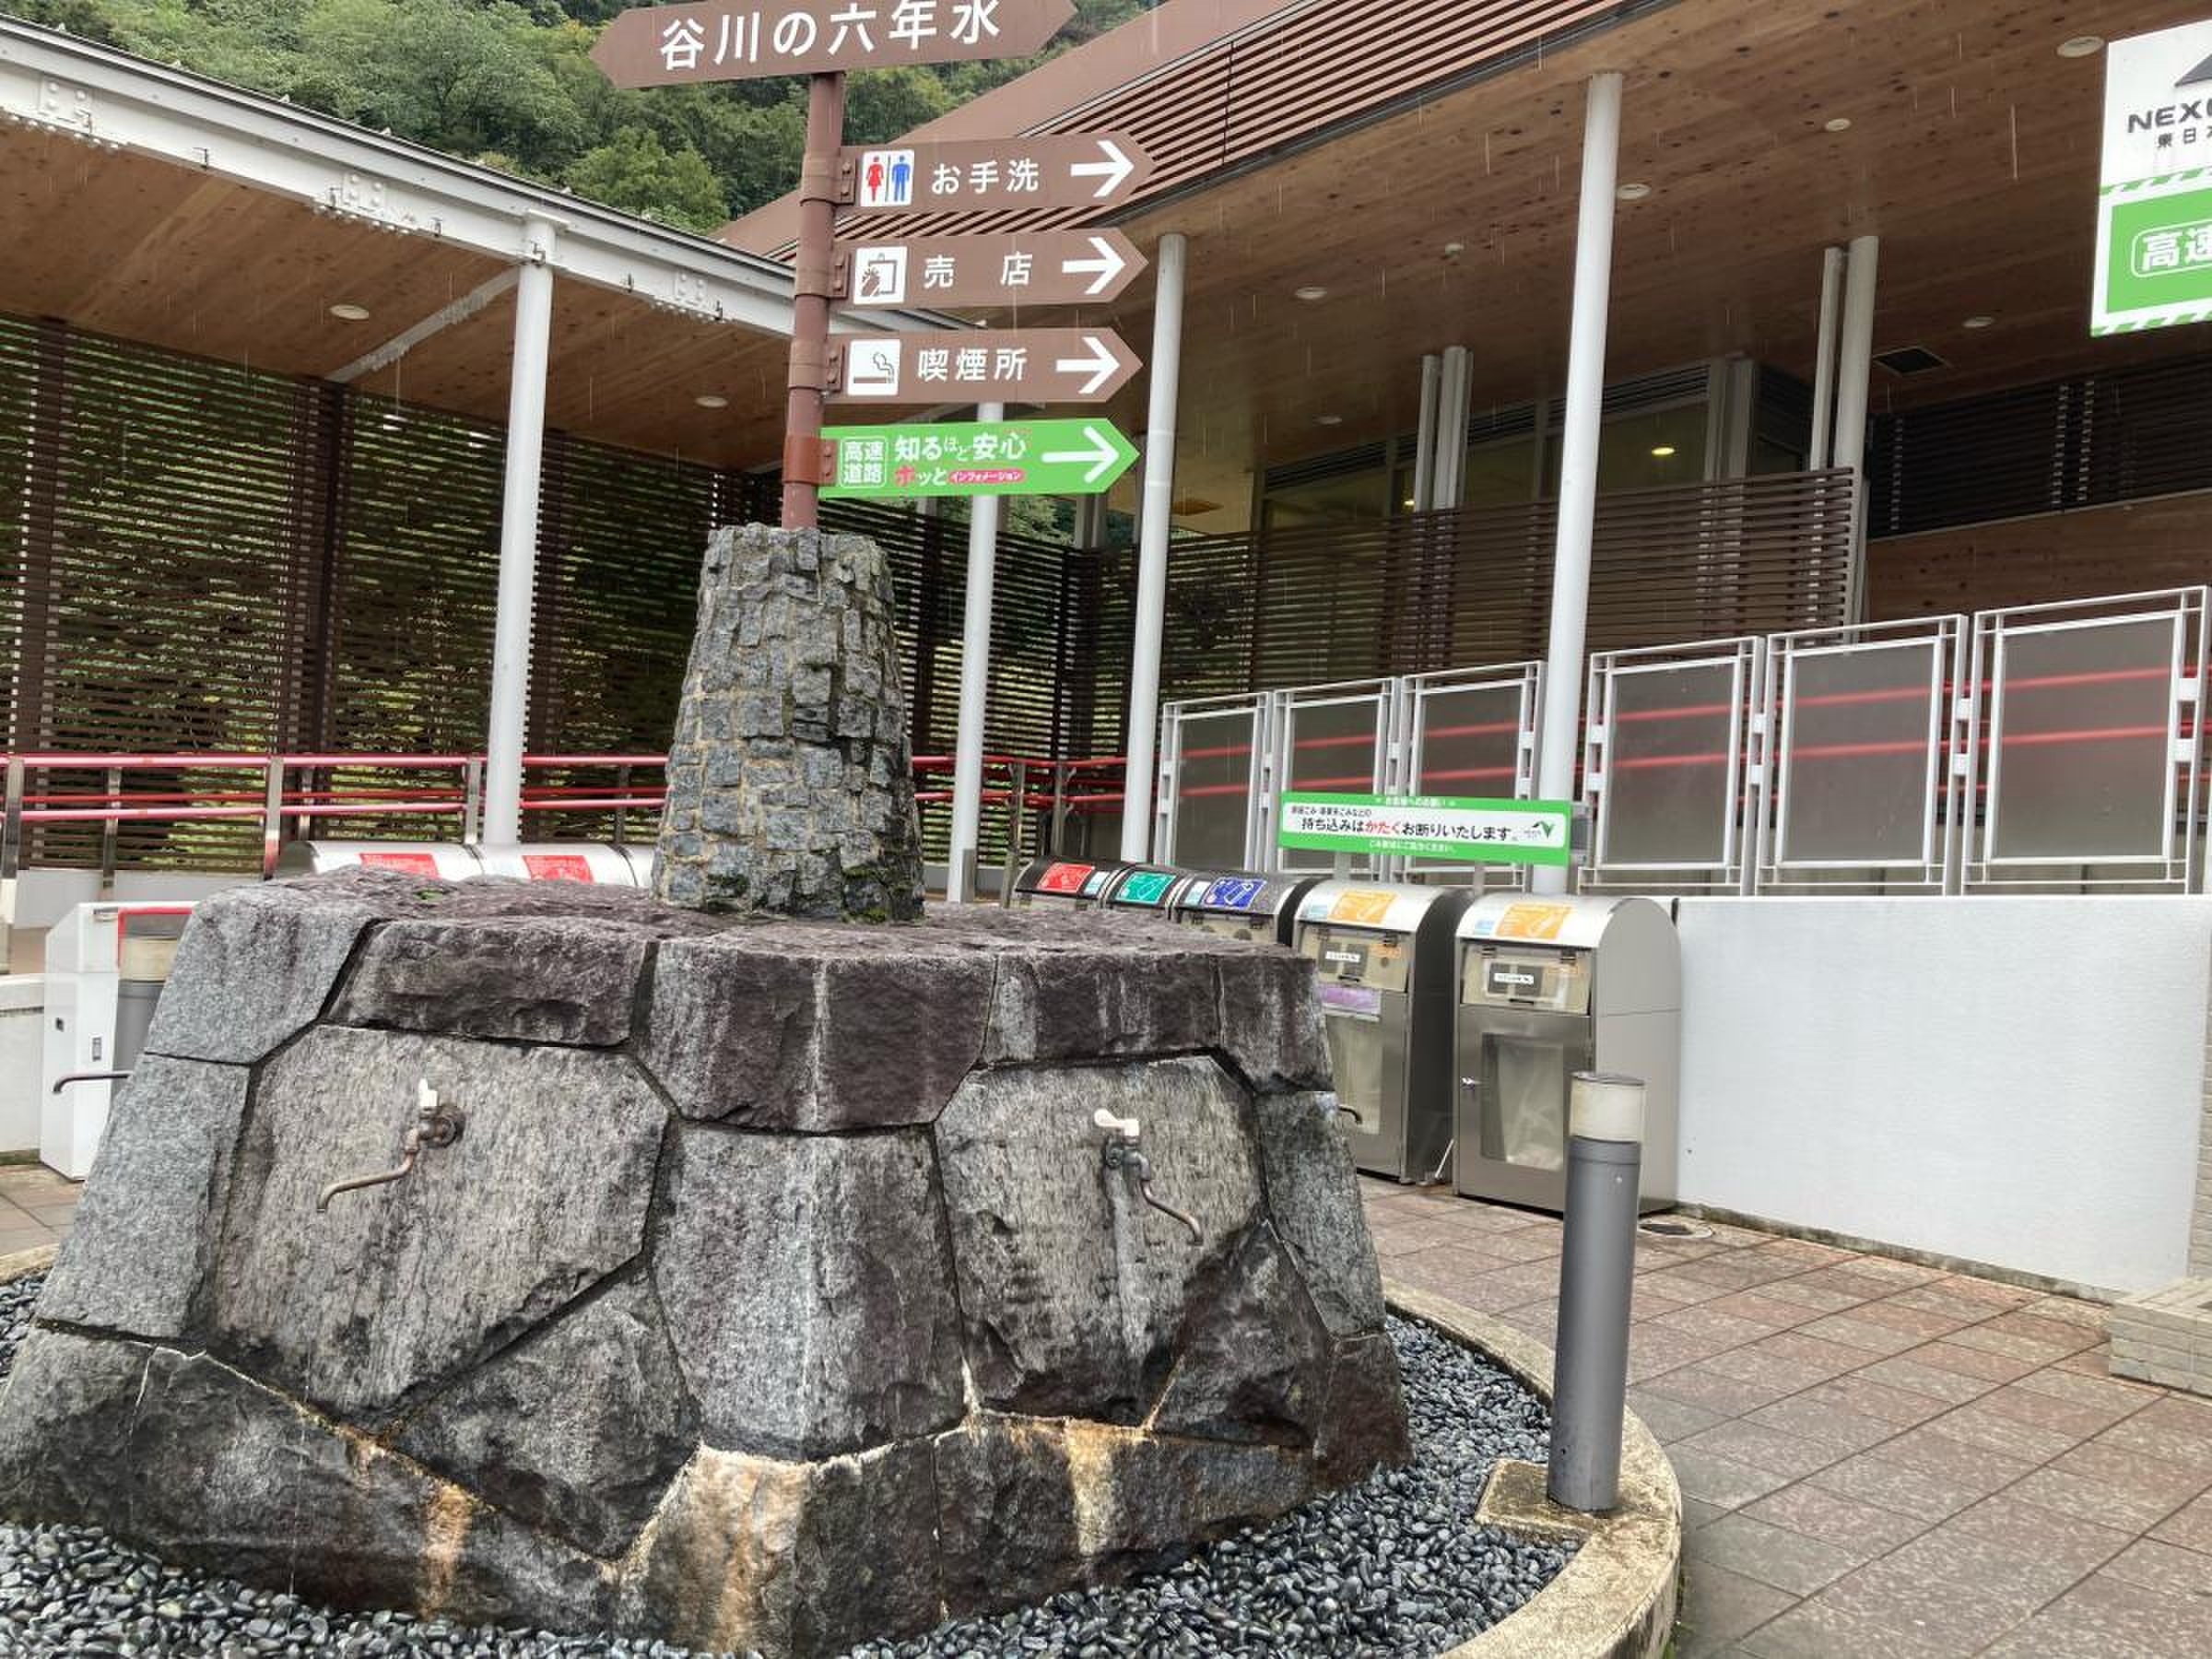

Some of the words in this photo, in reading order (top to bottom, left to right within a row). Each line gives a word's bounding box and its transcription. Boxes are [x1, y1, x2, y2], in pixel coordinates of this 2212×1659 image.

[660, 0, 1000, 71] 谷川の六年水
[2127, 98, 2212, 134] NEX
[2157, 124, 2212, 149] 東日
[931, 159, 1039, 196] お手洗
[917, 347, 1028, 382] 喫煙所
[895, 432, 1027, 462] 知るほど安心
